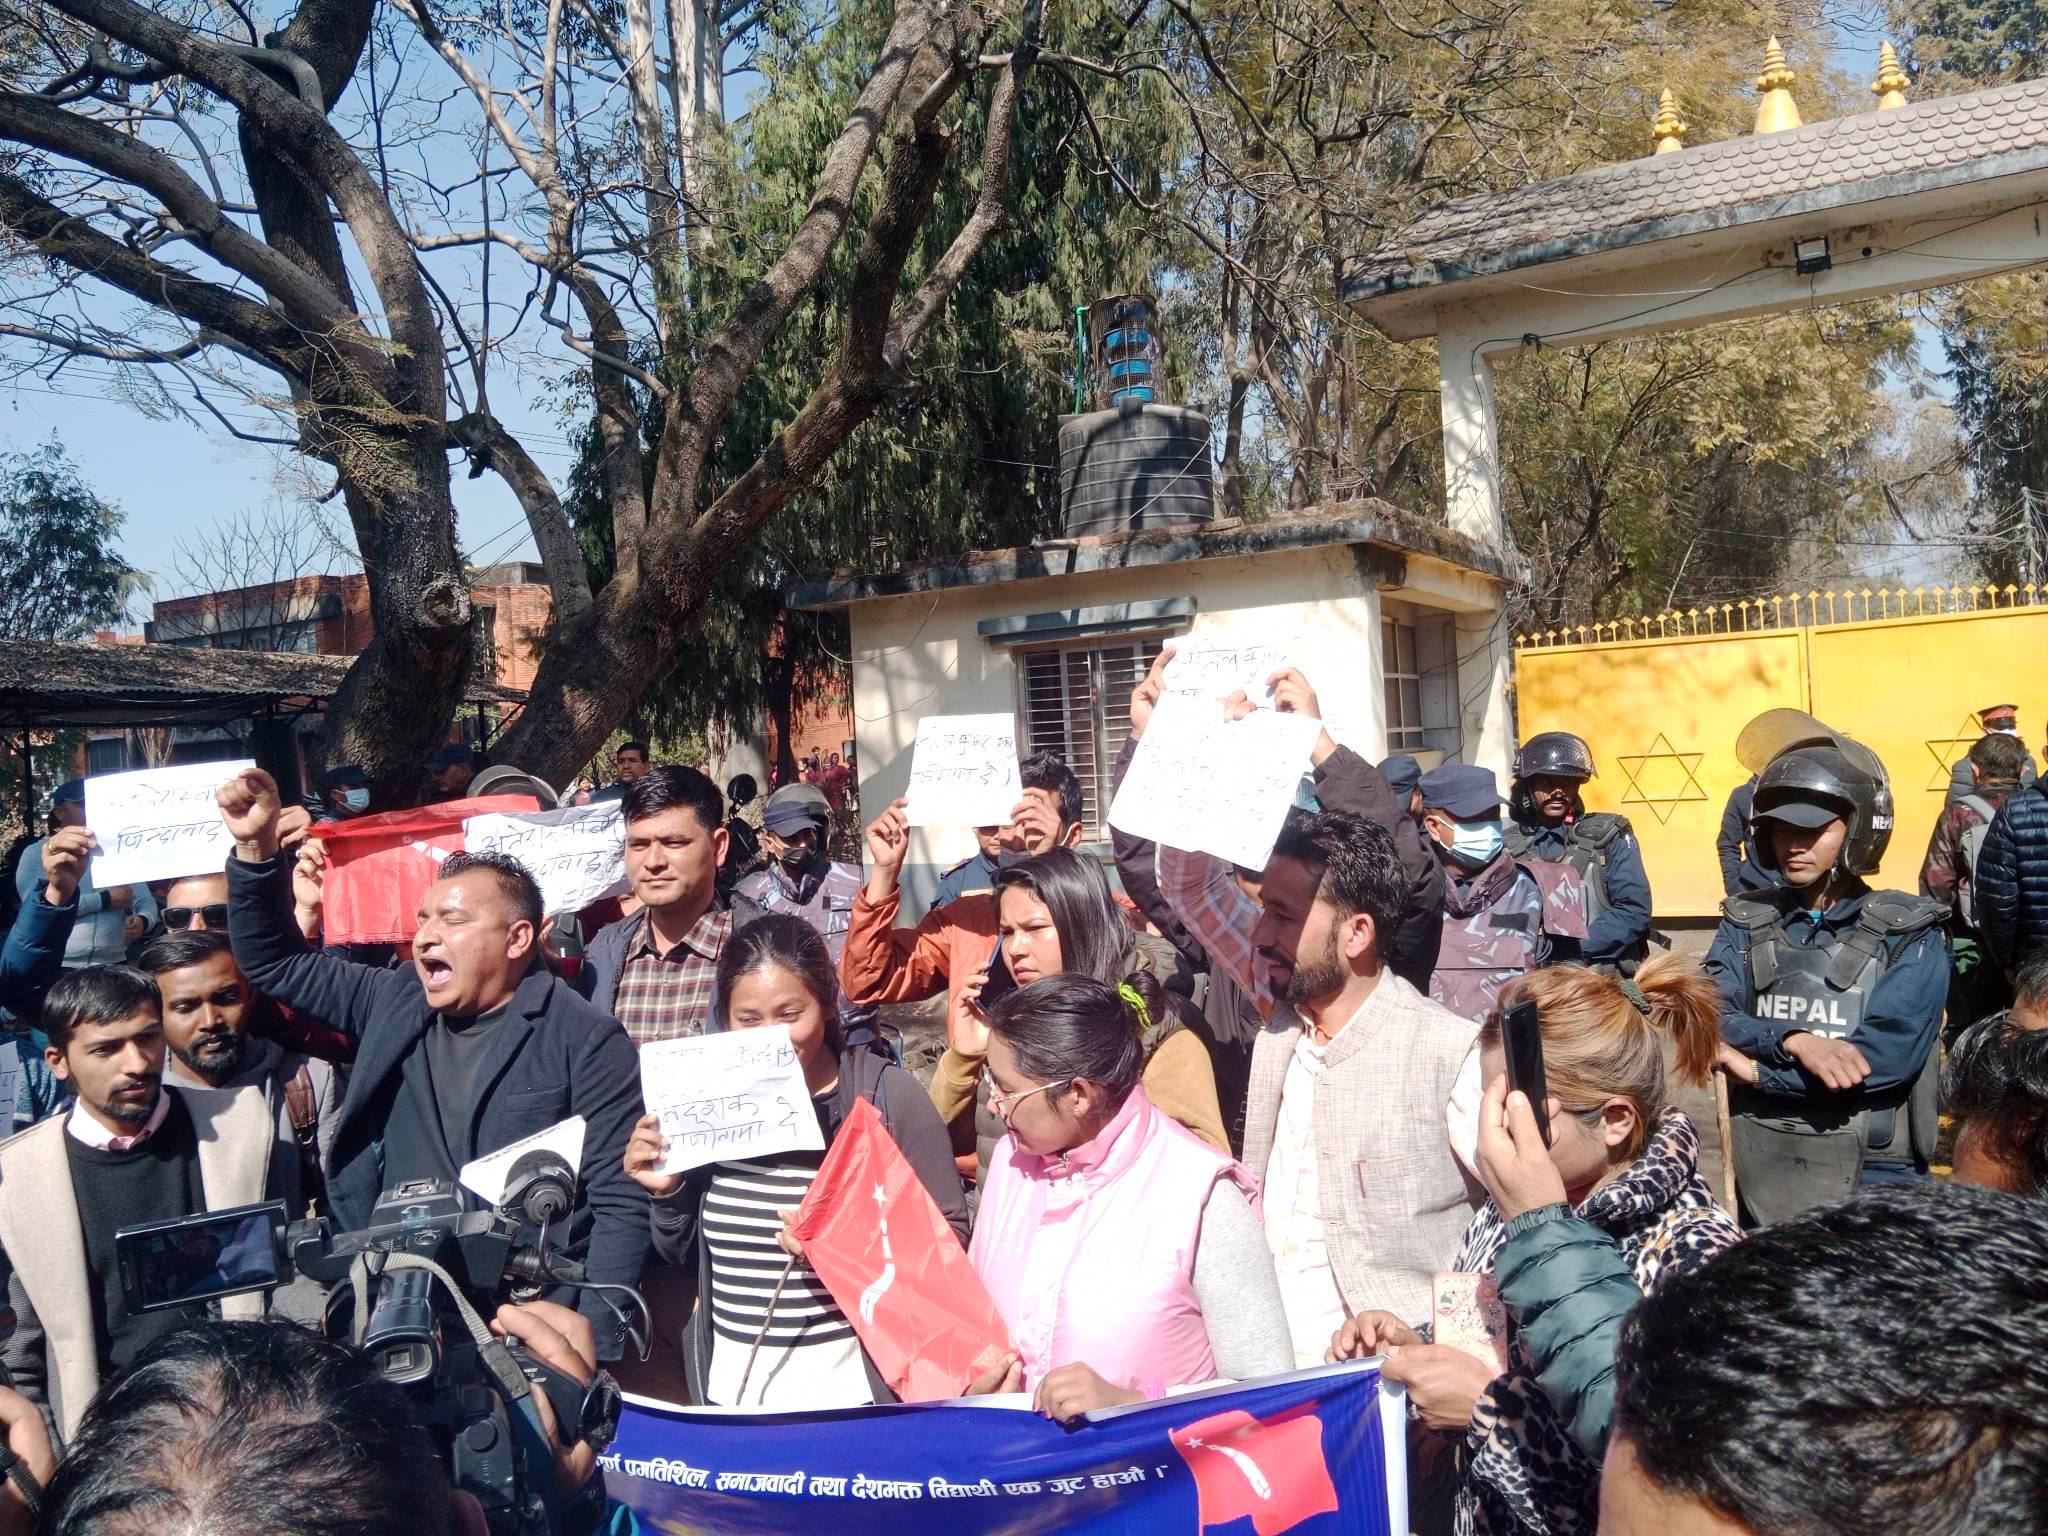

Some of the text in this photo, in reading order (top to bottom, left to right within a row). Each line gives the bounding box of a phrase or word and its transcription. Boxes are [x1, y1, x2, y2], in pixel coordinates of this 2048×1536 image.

[1756, 994, 1847, 1026] NEPAL
[715, 1470, 806, 1496] समाजवादी
[808, 1476, 849, 1497] तथा
[851, 1473, 924, 1500] देशभक्त
[1002, 1481, 1042, 1496] एक
[1046, 1476, 1086, 1496] जुट
